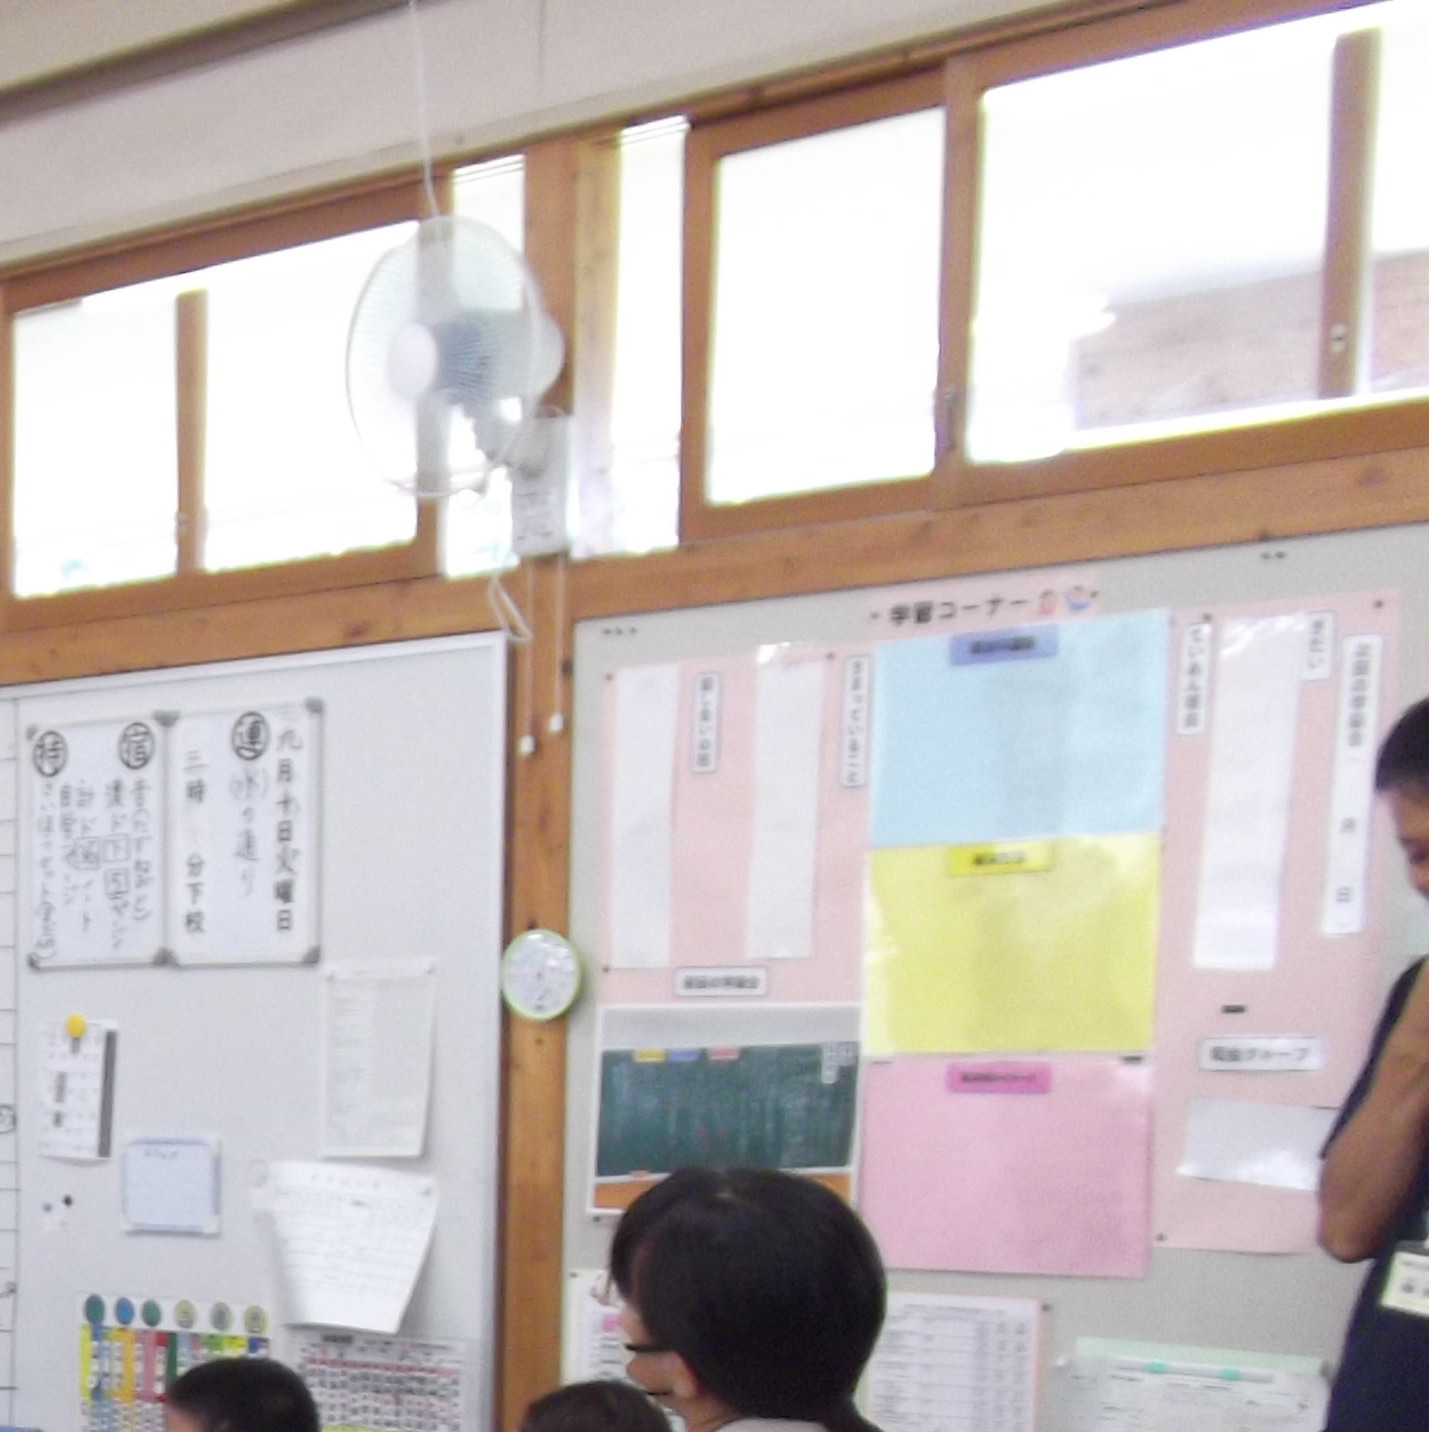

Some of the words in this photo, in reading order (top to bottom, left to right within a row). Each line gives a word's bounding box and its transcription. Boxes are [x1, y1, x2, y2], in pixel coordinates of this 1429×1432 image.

[889, 598, 1028, 626] 学習コーナー
